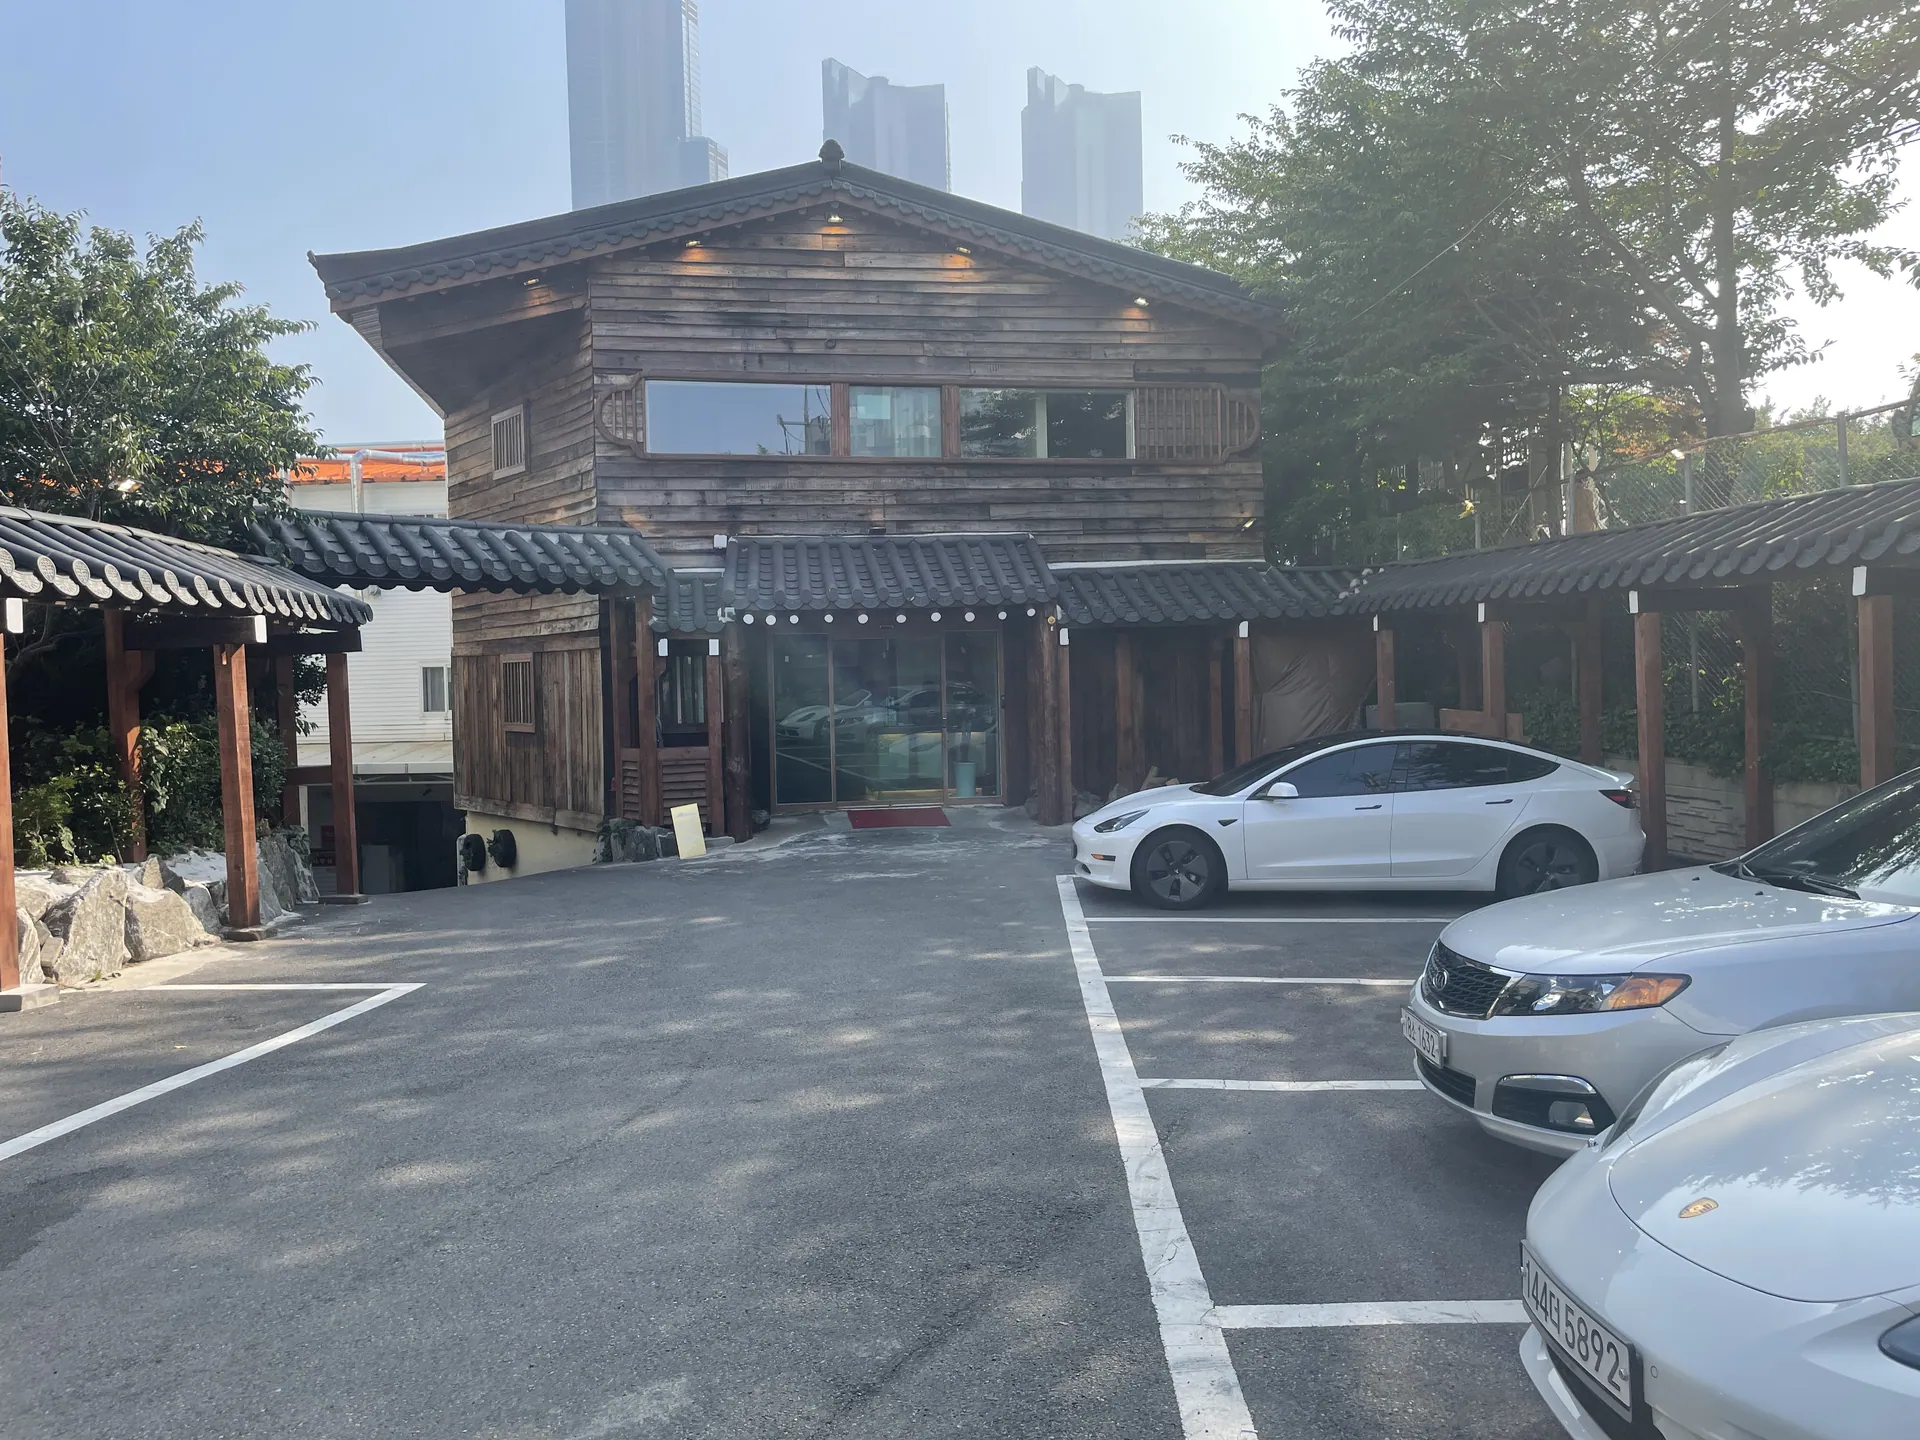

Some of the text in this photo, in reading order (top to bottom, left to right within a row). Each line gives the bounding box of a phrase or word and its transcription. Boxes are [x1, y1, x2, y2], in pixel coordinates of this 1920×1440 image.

[1418, 1025, 1436, 1058] 1632
[1526, 1260, 1621, 1392] 144더 5892
